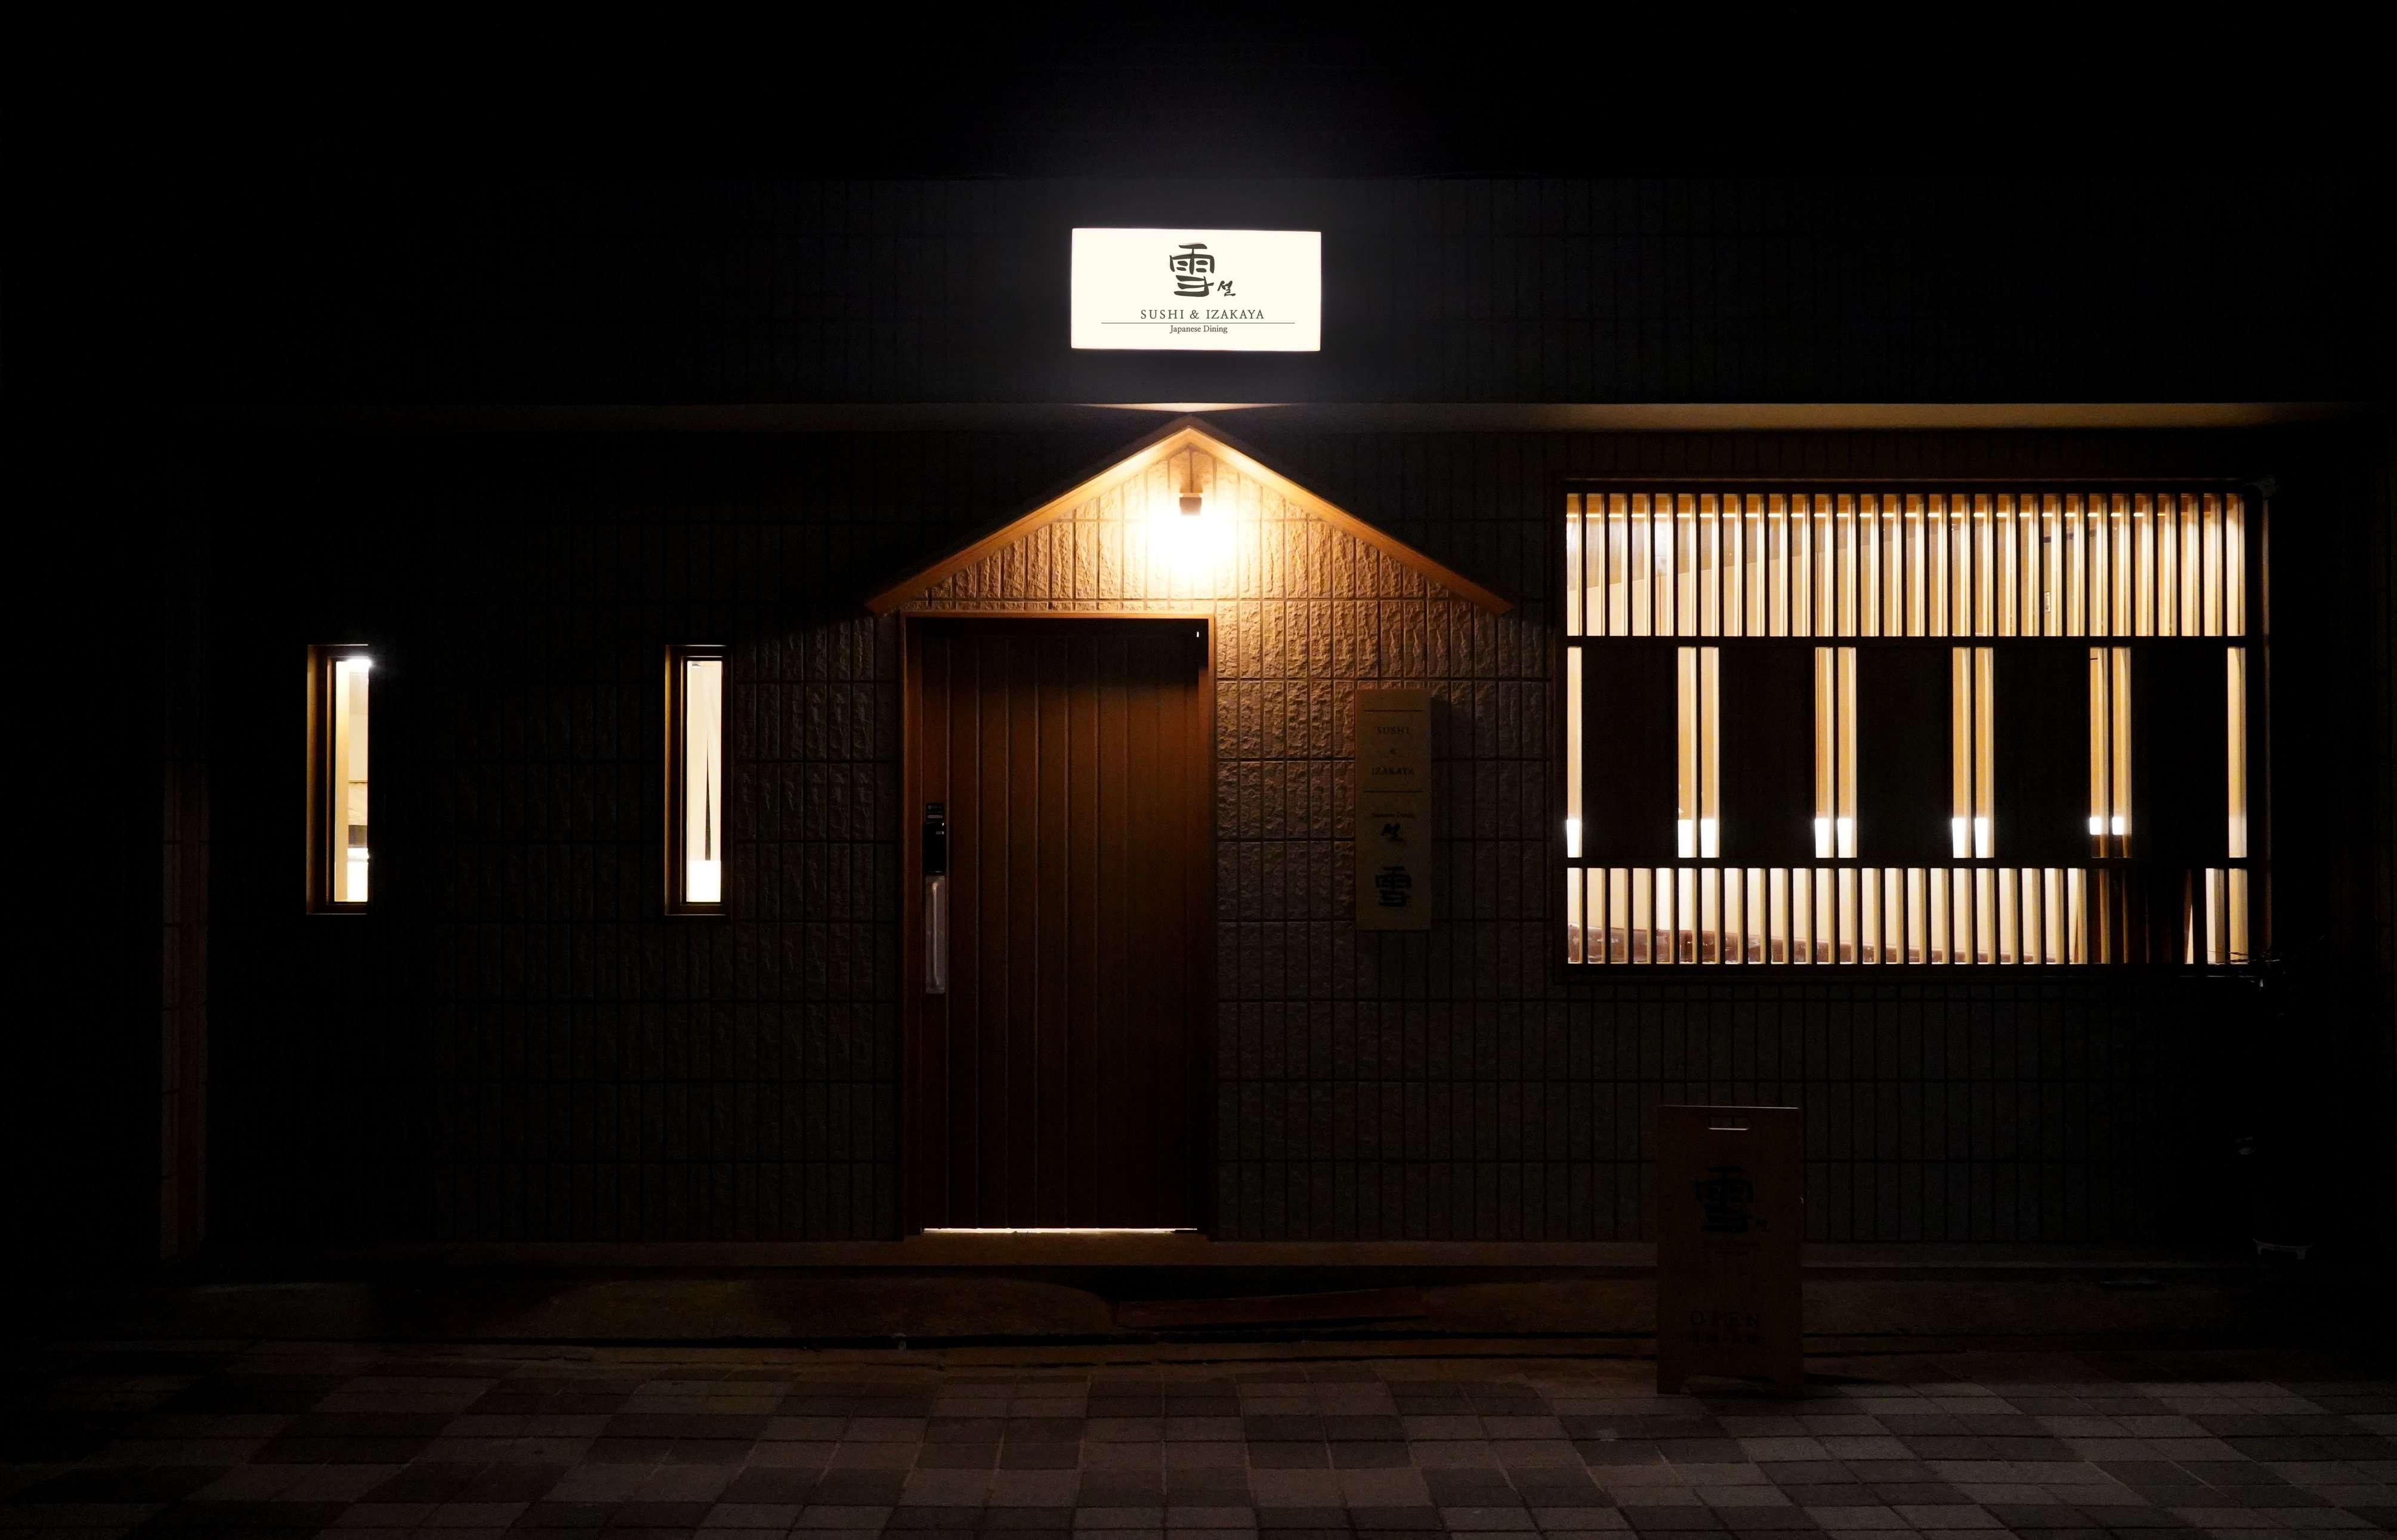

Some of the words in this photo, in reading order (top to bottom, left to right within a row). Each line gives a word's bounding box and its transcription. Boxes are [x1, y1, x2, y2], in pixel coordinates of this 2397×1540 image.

[1169, 243, 1215, 297] 雪
[1140, 310, 1184, 320] SUSHI
[1190, 310, 1200, 319] &
[1206, 310, 1265, 319] IZAKAYA
[1169, 325, 1201, 334] Japanese
[1203, 325, 1228, 334] Dining
[1376, 726, 1410, 735] SUSHI
[1371, 766, 1414, 776] IZAKAYA
[1690, 1310, 1760, 1328] OPEN
